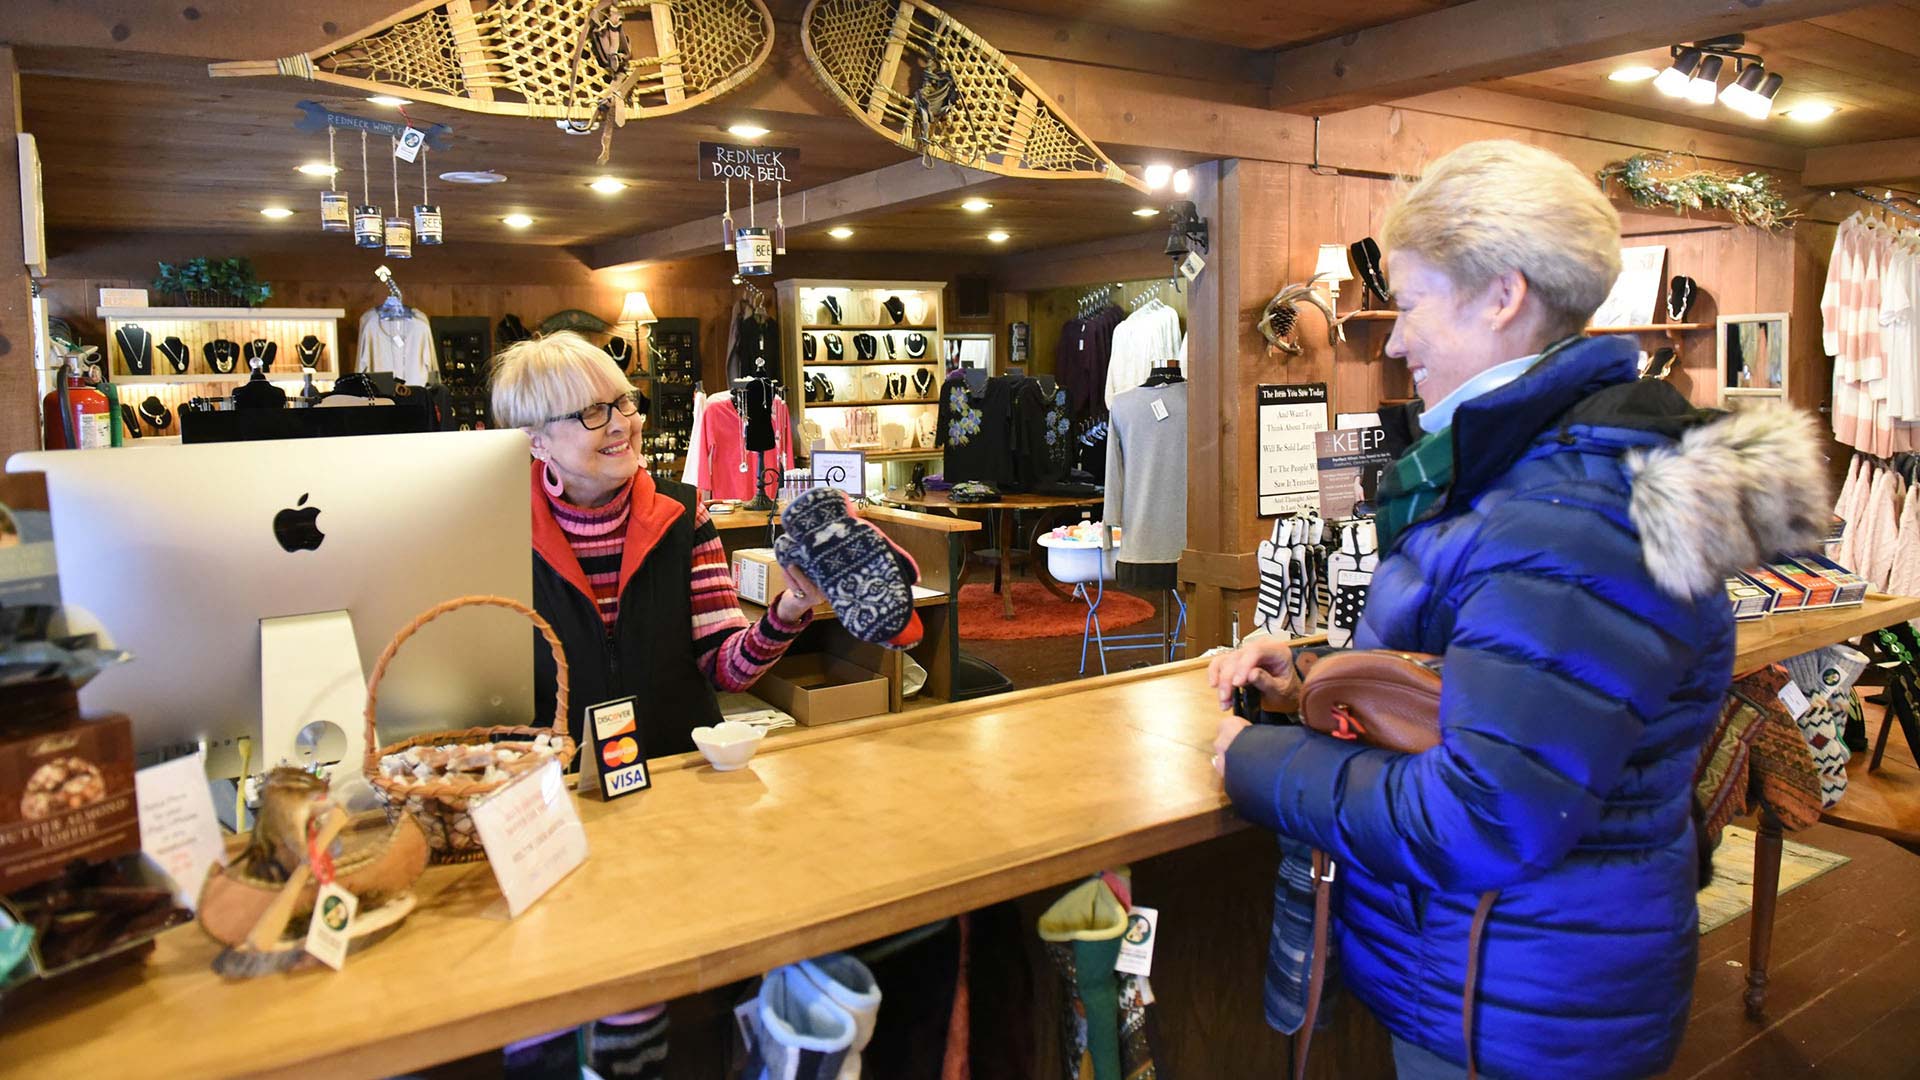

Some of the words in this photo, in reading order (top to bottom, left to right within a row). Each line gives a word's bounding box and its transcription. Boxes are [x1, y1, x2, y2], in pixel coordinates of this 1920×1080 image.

[327, 113, 370, 130] REDNECK
[372, 122, 395, 134] WIND
[716, 147, 784, 168] REDNECK
[712, 161, 755, 180] DOOR
[757, 166, 791, 182] BELL
[1263, 390, 1273, 399] The
[1274, 389, 1287, 398] Item
[1287, 388, 1297, 397] You
[1298, 388, 1308, 397] Saw
[1308, 387, 1324, 398] Today
[1305, 409, 1312, 417] To
[1266, 424, 1283, 432] Think
[1285, 423, 1300, 431] About
[1301, 421, 1323, 431] Tonight
[1263, 444, 1275, 453] Will
[1284, 442, 1296, 451] Sold
[1297, 442, 1311, 450] Later
[1332, 429, 1385, 453] KEEP
[1269, 465, 1277, 473] To
[1279, 464, 1289, 473] The
[1291, 463, 1308, 472] People
[1292, 478, 1317, 487] Yesterday
[597, 709, 631, 724] DISCOVER
[611, 769, 643, 790] VISA
